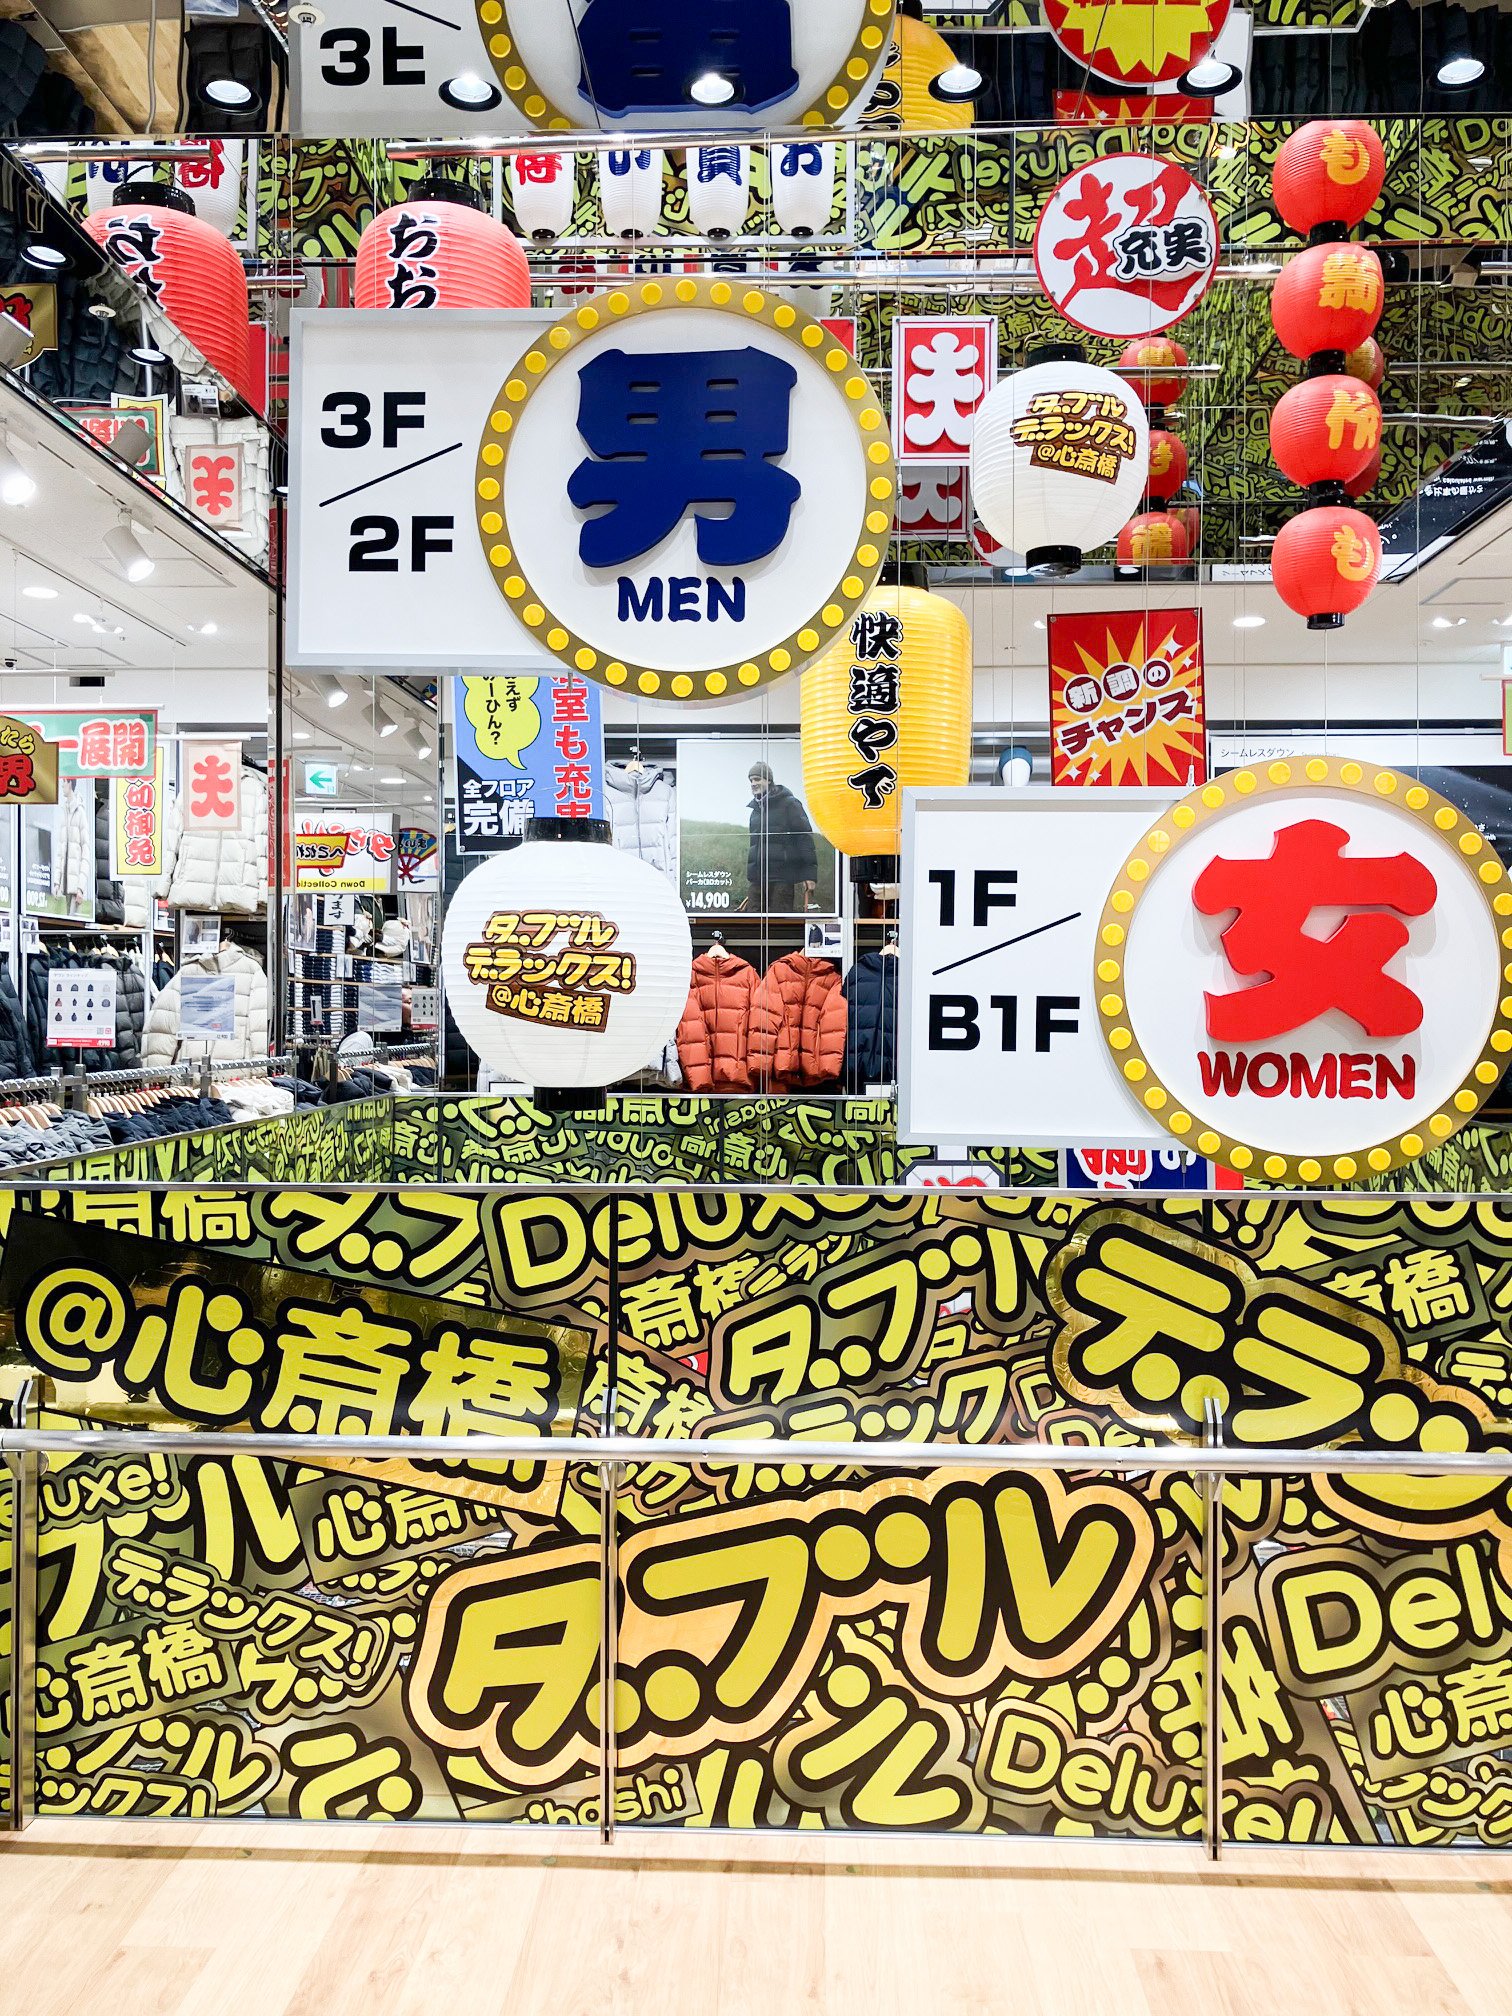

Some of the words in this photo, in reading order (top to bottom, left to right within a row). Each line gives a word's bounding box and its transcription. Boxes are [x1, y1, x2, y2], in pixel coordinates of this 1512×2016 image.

[1119, 222, 1208, 277] 充実
[321, 391, 426, 449] 3F
[567, 345, 800, 567] 男
[349, 515, 454, 572] 2F
[617, 576, 746, 623] MEN
[848, 611, 905, 810] 快適やで
[1067, 663, 1170, 709] 新調の
[1058, 688, 1195, 755] チャンス
[463, 779, 534, 798] 全フロア
[686, 891, 730, 909] ¥14,900
[929, 870, 1018, 927] 1F
[486, 912, 617, 948] ダブル
[1191, 818, 1438, 1044] 女
[466, 946, 635, 991] デラックス!
[492, 986, 605, 1027] @心斎橋
[929, 995, 1080, 1053] B1F
[1197, 1051, 1417, 1101] WOMEN
[25, 1267, 552, 1483] @心斎橋
[112, 1547, 374, 1677] デラックス!
[441, 1486, 1119, 1752] ダブル
